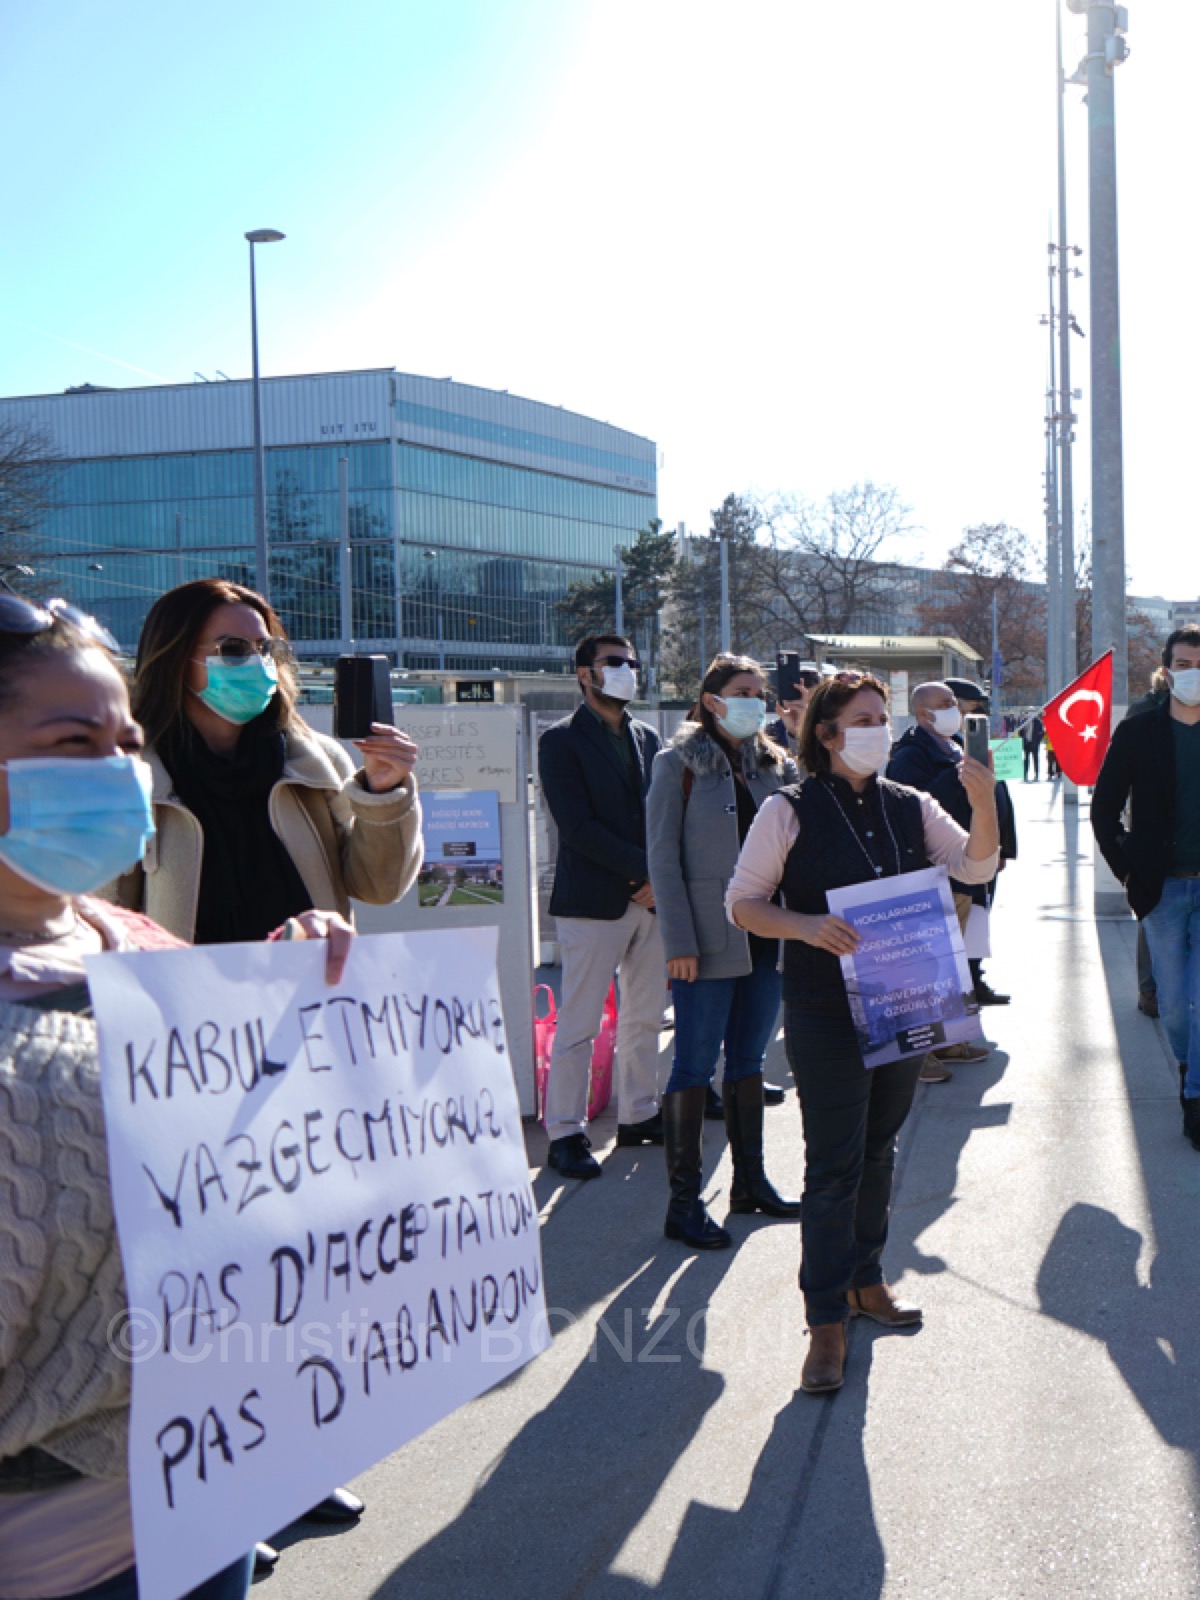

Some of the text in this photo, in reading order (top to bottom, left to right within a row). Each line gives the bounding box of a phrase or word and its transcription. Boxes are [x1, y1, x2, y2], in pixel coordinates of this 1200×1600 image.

[320, 422, 377, 435] UIT ITU
[449, 721, 479, 737] LES
[416, 741, 487, 761] VERSITÉS
[890, 921, 905, 931] VE
[125, 1017, 287, 1104] KABUL
[158, 1186, 534, 1354] PAS D'ACCEPTATION
[155, 1257, 540, 1508] PAS D'ABANDON
